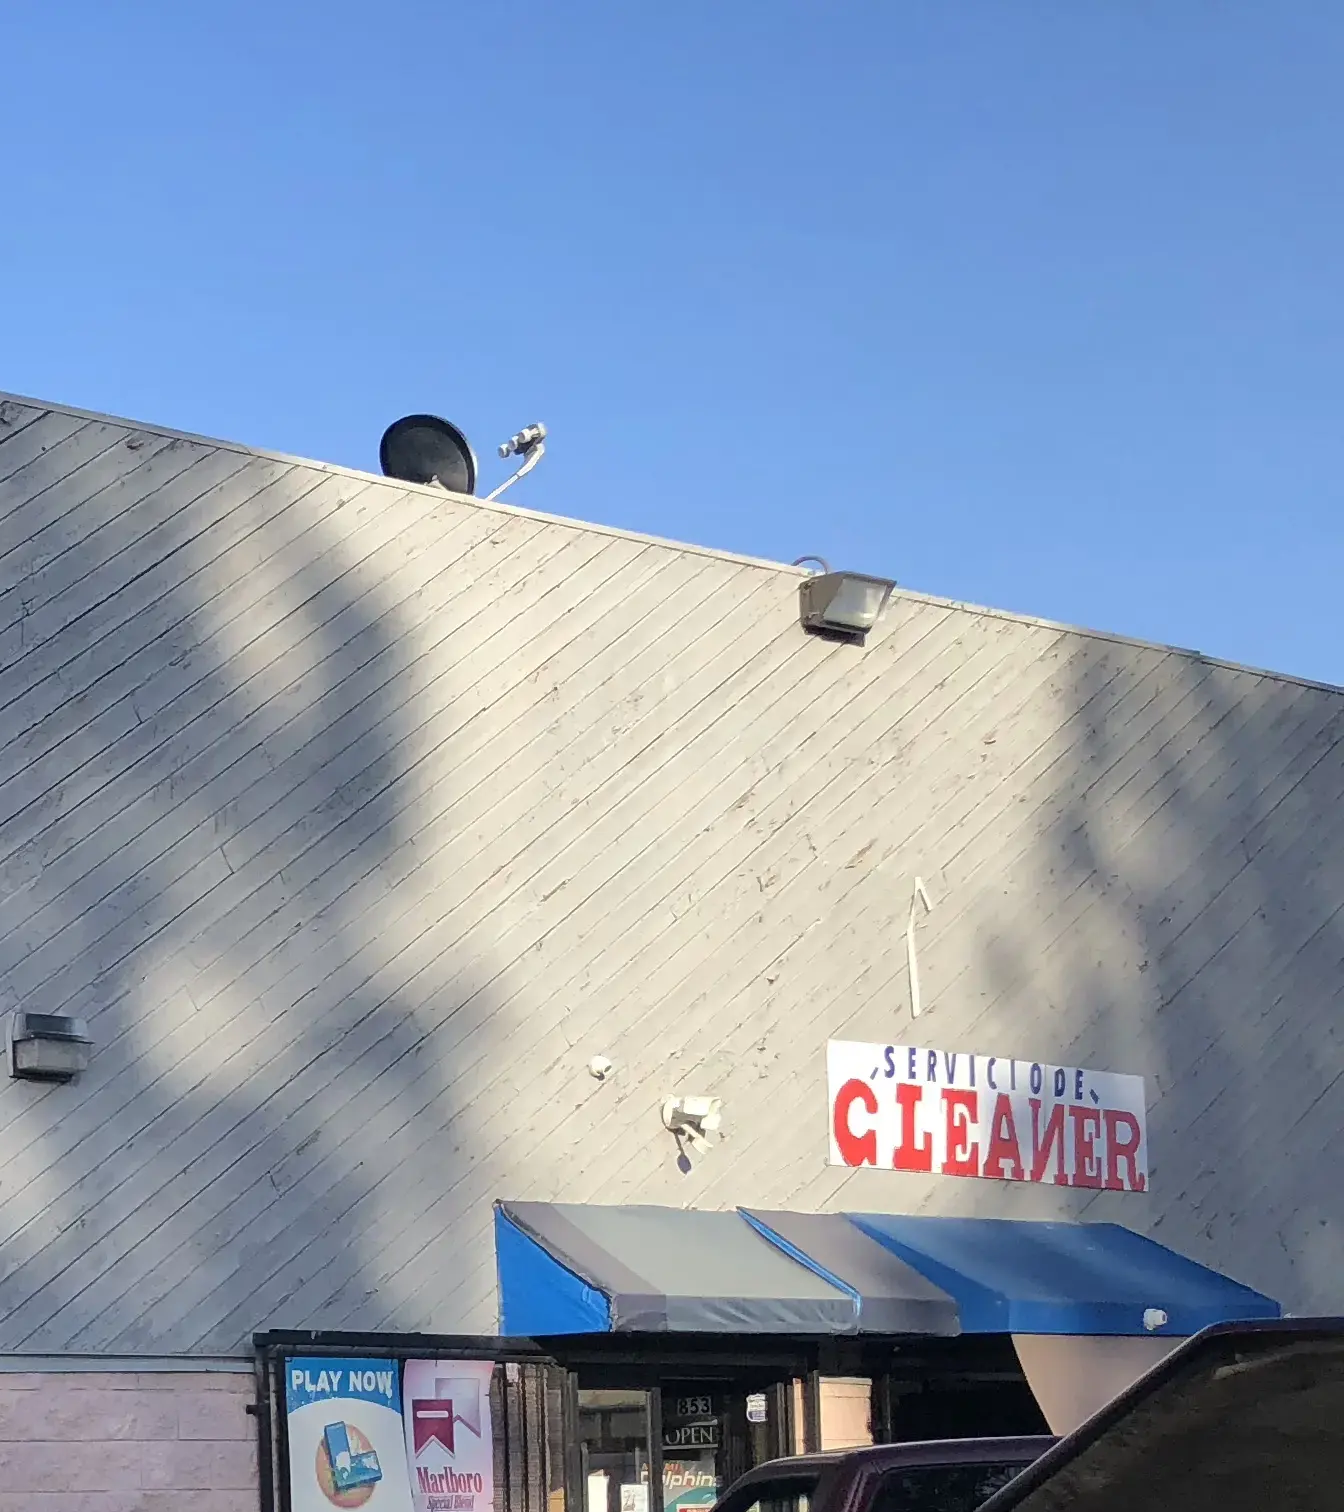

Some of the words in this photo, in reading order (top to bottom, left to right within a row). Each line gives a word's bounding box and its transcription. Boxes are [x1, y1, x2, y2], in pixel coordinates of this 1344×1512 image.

[833, 1078, 1145, 1192] CLEANER
[292, 1369, 342, 1392] PLAY
[349, 1370, 393, 1398] NOW
[679, 1397, 710, 1414] 853
[665, 1426, 713, 1444] OPEN
[416, 1466, 483, 1493] Marlboro
[640, 1470, 724, 1490] Dlphins
